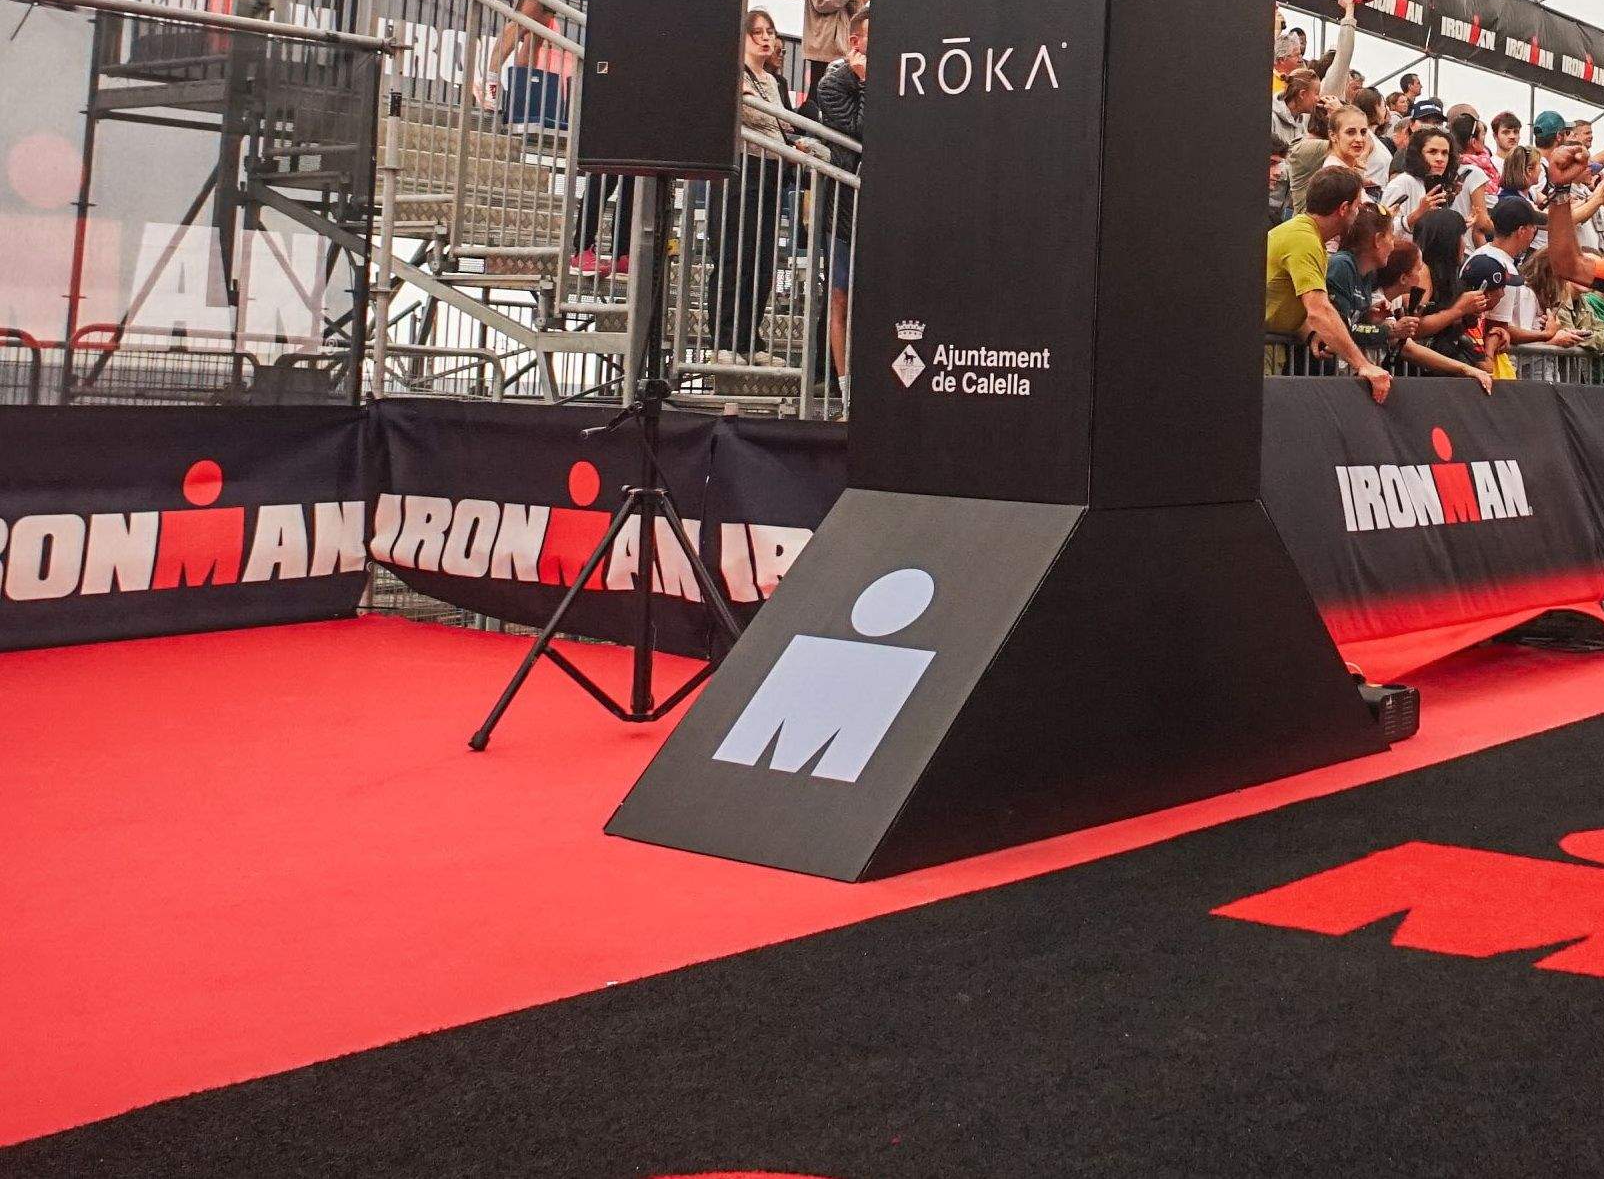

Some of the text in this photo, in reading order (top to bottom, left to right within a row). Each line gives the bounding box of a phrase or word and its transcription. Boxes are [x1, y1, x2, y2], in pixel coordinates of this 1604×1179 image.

[932, 371, 1031, 396] de Calella
[933, 344, 1050, 371] Ajuntament
[0, 459, 367, 600] ONMAN
[370, 461, 704, 603] IRONMAN
[1335, 427, 1531, 532] IRONMAN
